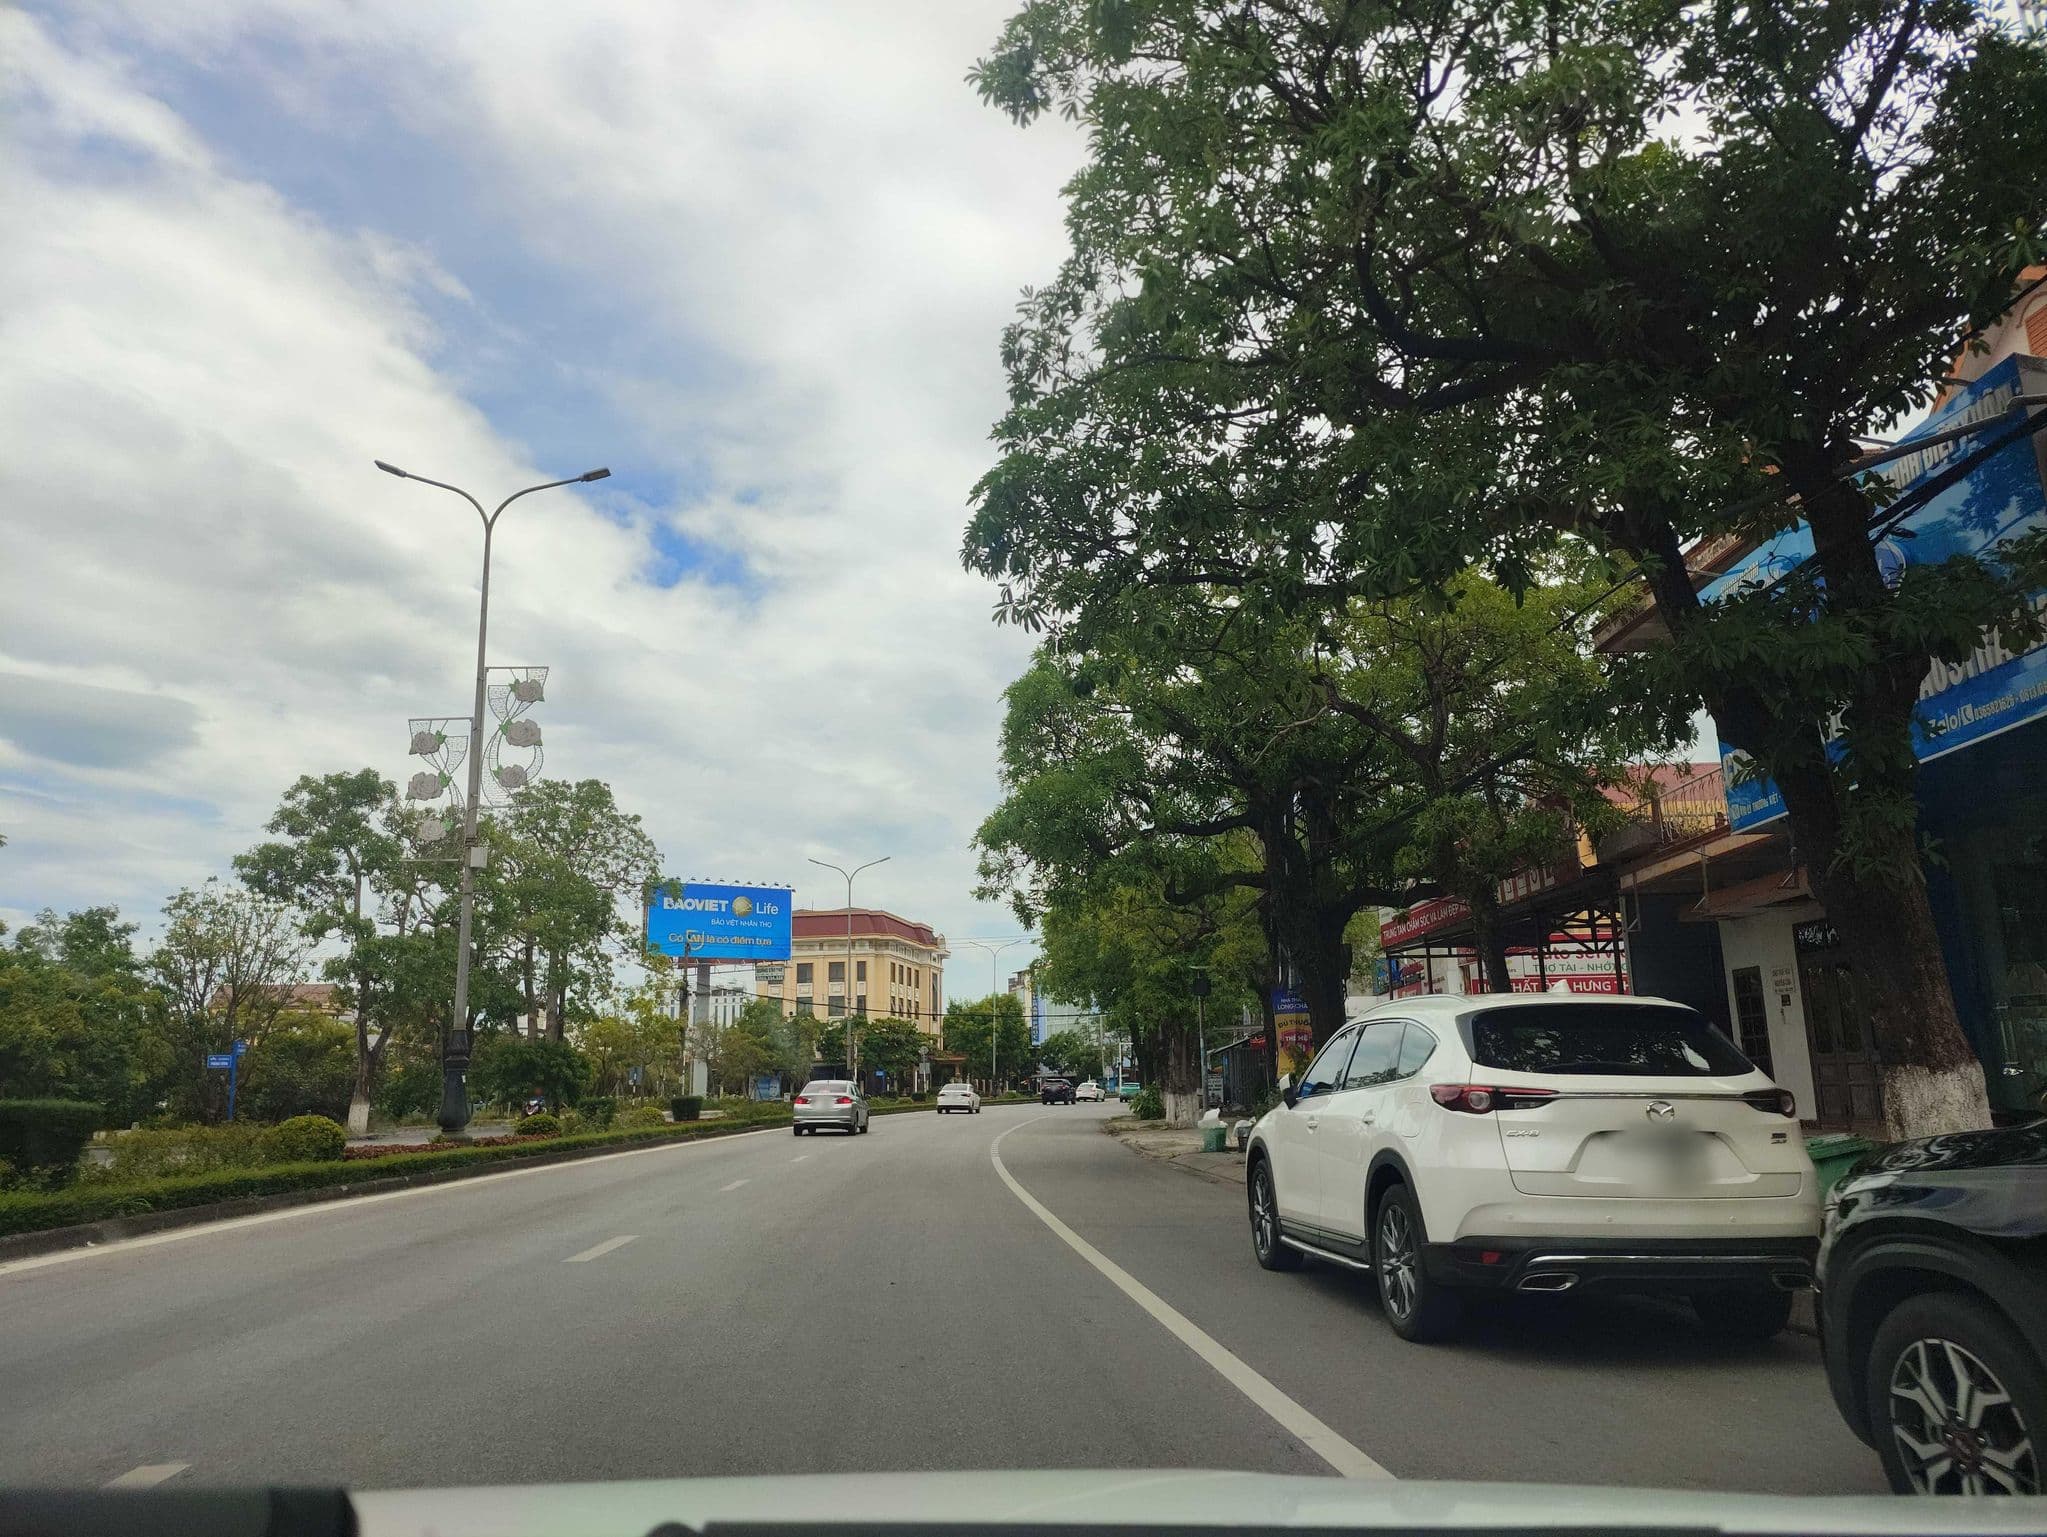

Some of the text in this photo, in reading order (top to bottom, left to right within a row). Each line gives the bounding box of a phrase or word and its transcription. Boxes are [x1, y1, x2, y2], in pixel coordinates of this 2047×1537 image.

[663, 897, 779, 915] BAOVIET Life
[1559, 961, 1577, 972] TÀI
[1587, 961, 1616, 972] NHỚ
[1572, 980, 1612, 993] HƯNG
